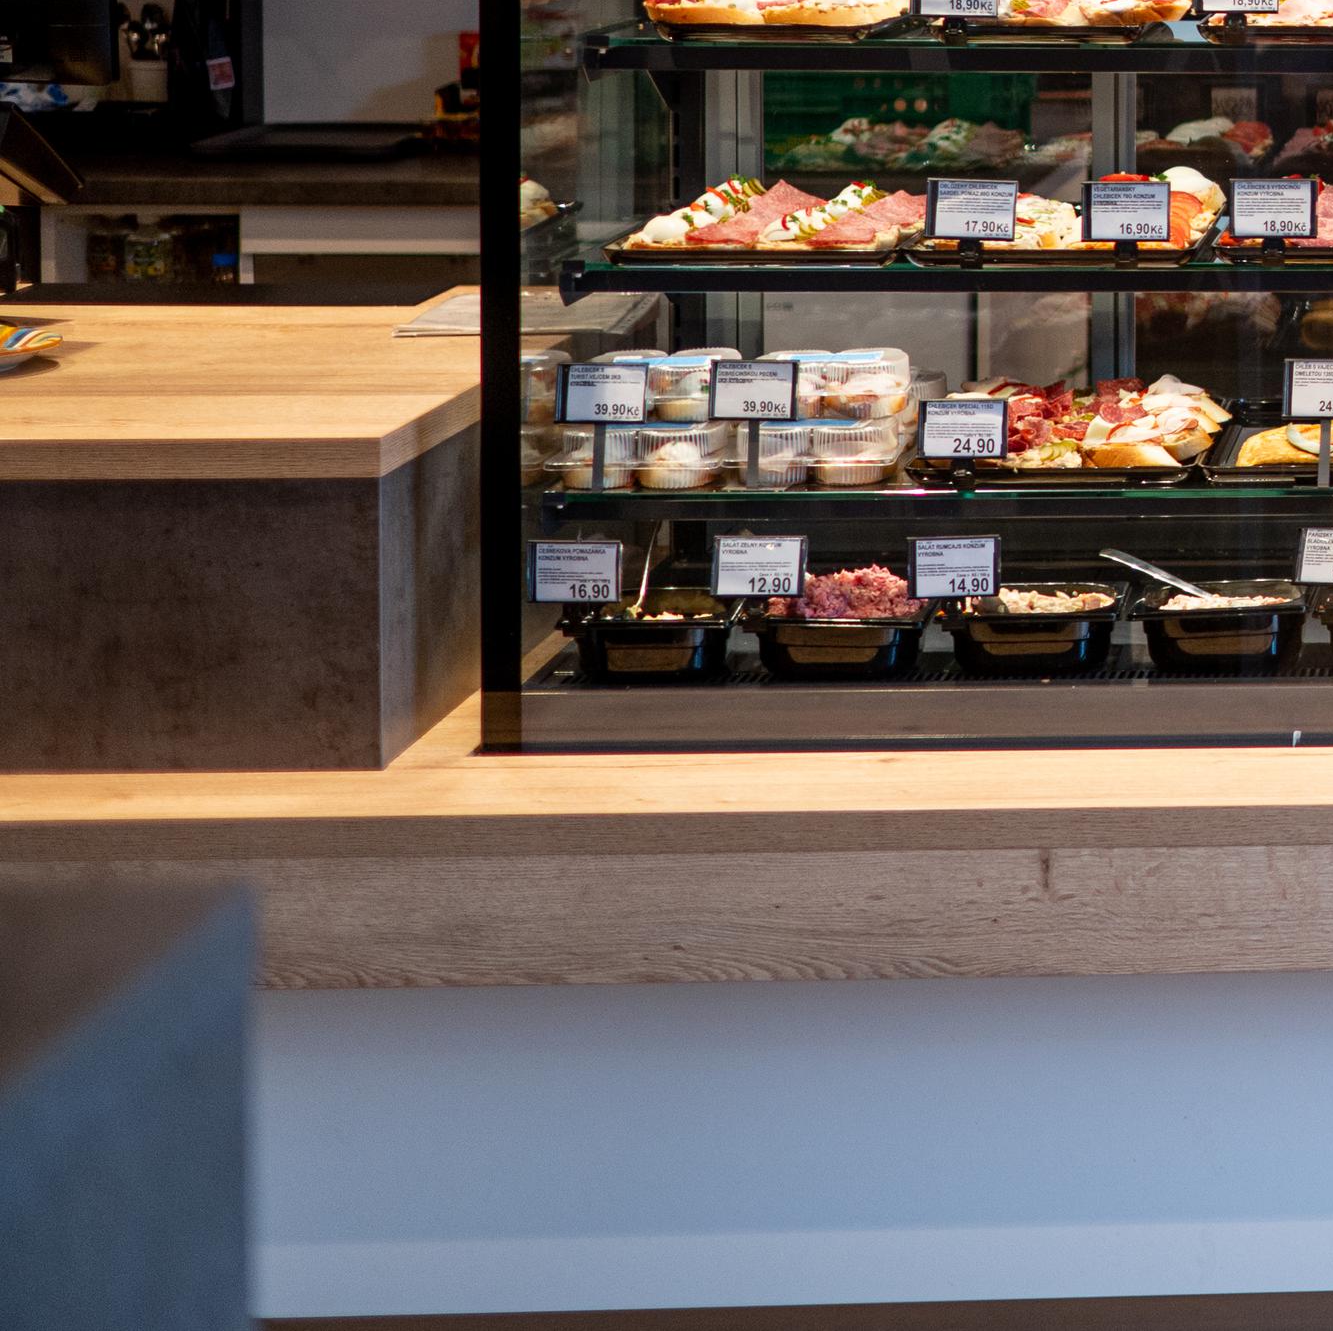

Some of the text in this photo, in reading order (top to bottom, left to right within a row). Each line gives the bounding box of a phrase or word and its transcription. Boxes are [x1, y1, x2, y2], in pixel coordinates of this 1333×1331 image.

[953, 438, 995, 456] 24,90
[569, 584, 610, 601] 16,90
[748, 577, 791, 594] 12,90
[949, 578, 989, 595] 14,90
